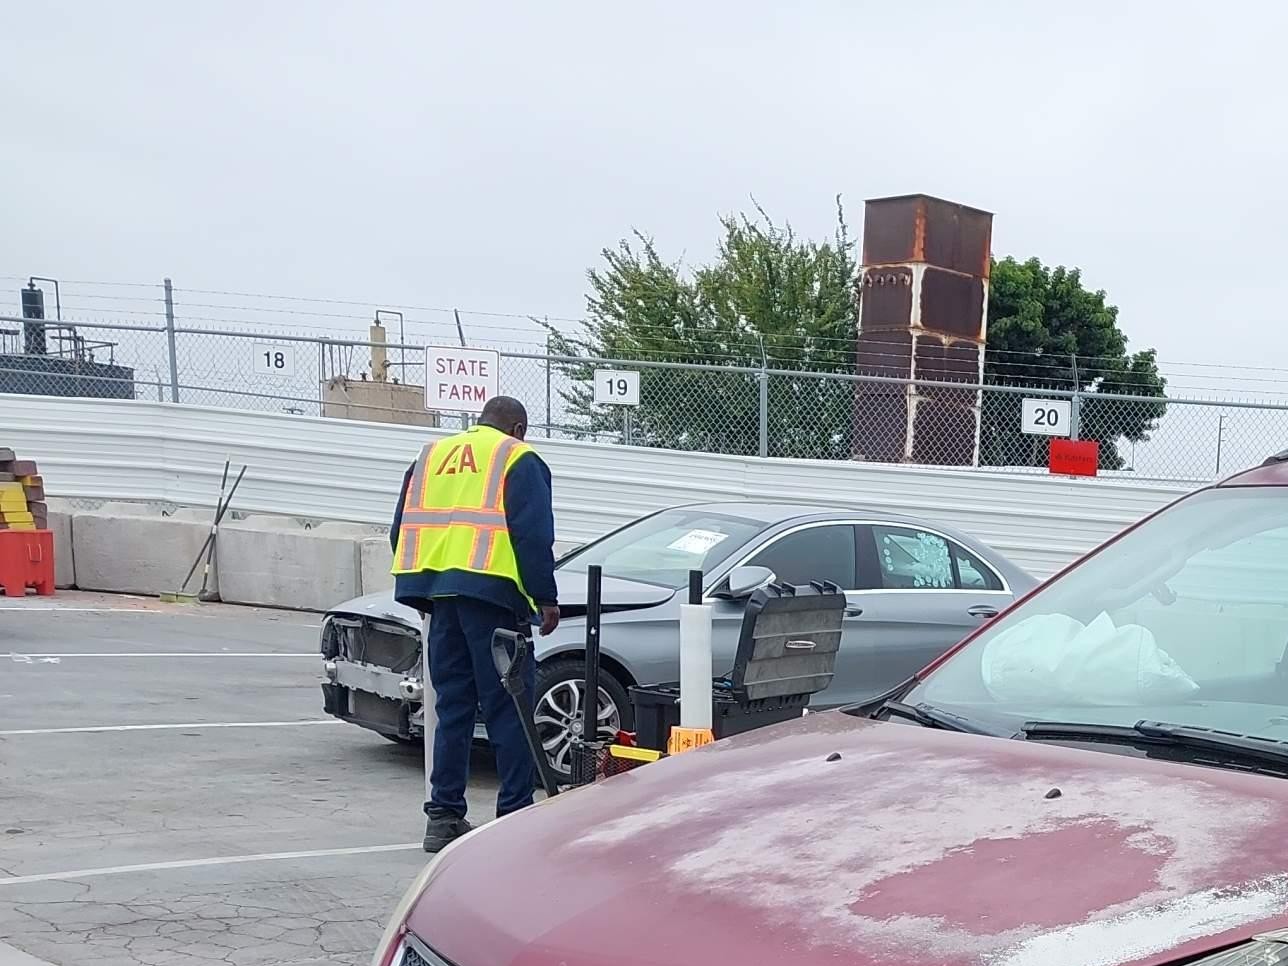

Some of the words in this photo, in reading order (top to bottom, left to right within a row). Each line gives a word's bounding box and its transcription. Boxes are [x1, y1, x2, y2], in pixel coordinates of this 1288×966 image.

[263, 351, 286, 369] 18
[435, 358, 489, 378] STATE
[438, 384, 486, 402] FARM
[605, 378, 628, 396] 19
[1033, 407, 1059, 427] 20
